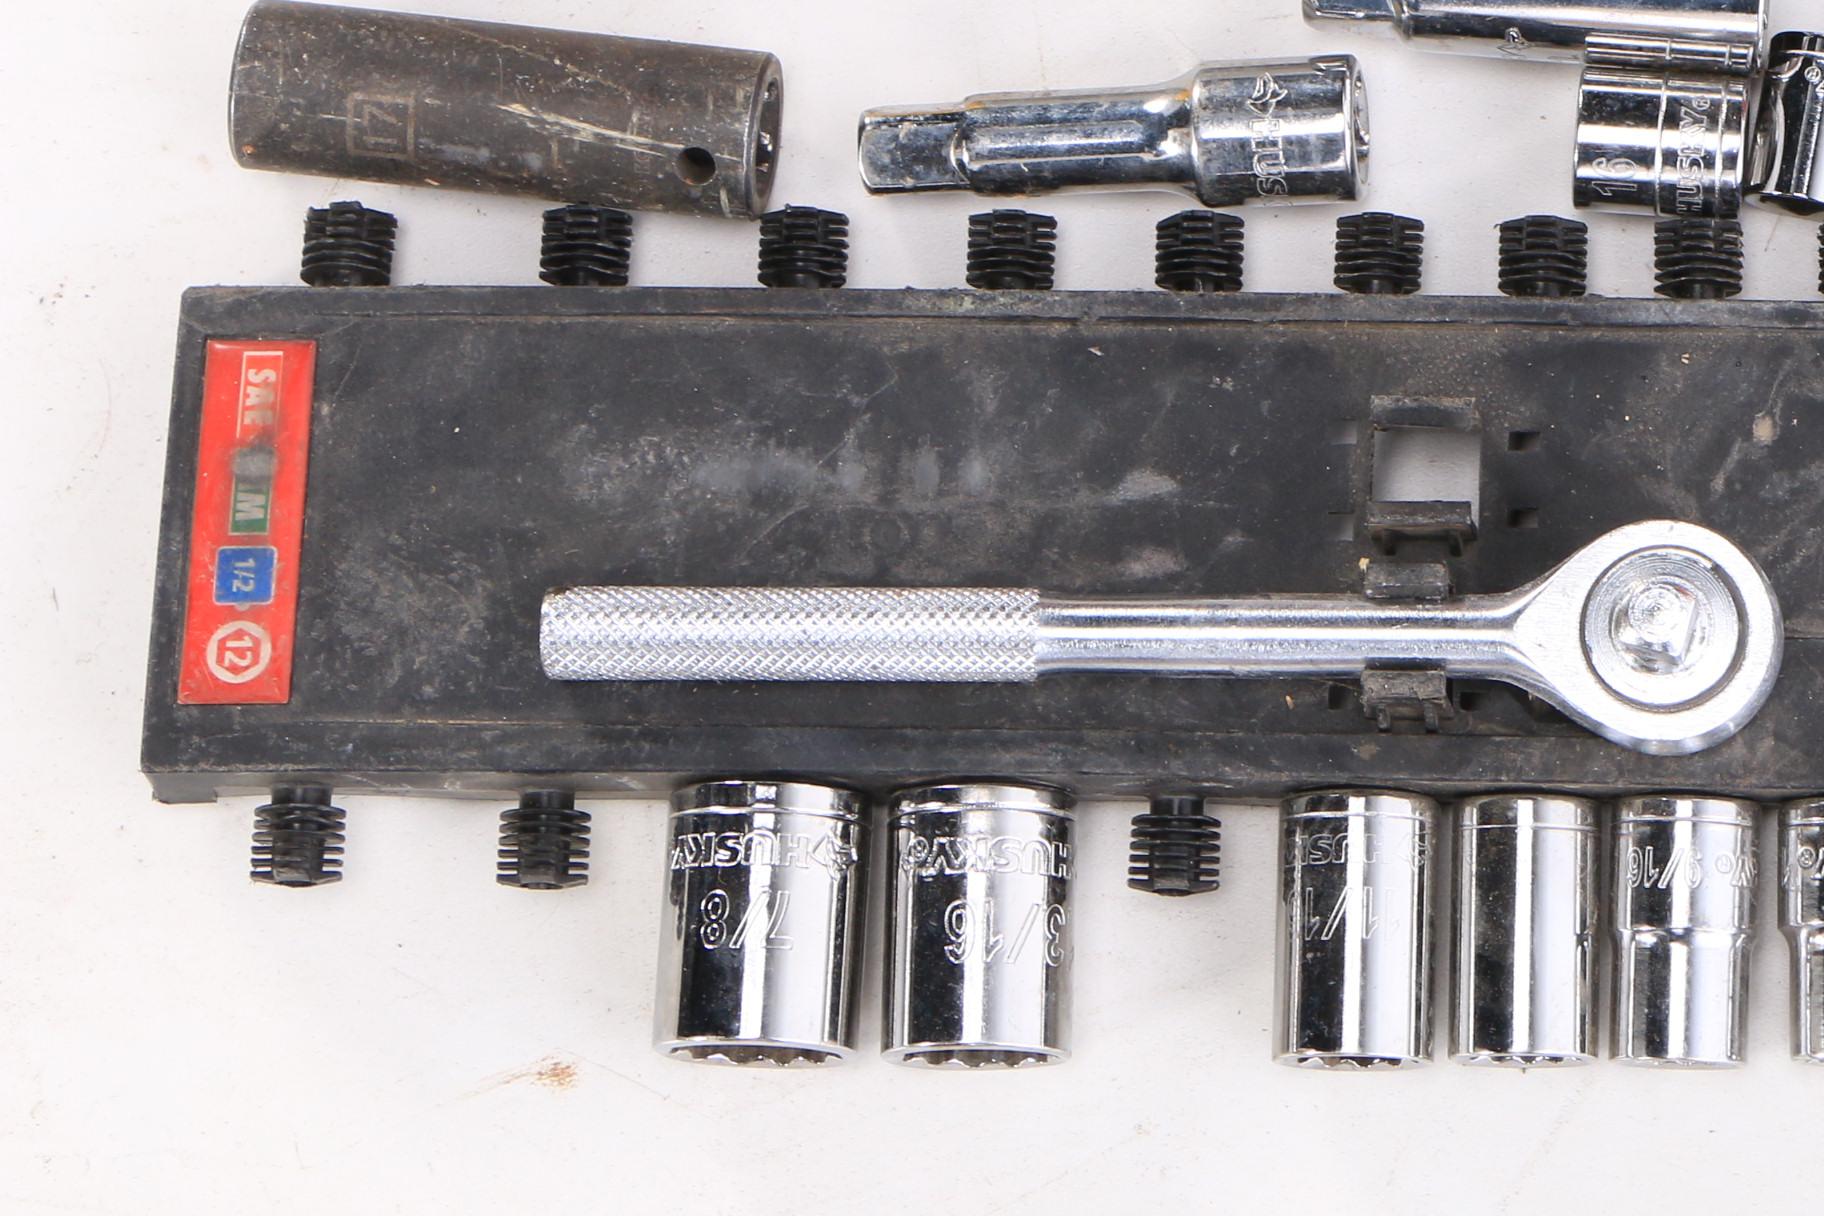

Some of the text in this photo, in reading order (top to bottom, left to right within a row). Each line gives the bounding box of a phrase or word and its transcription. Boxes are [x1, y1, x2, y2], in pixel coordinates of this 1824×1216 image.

[1590, 155, 1640, 198] 16
[243, 368, 277, 427] SAE
[231, 557, 257, 593] 1/2
[223, 635, 254, 669] 12
[1626, 844, 1702, 889] 9/16
[698, 888, 795, 951] 7/8
